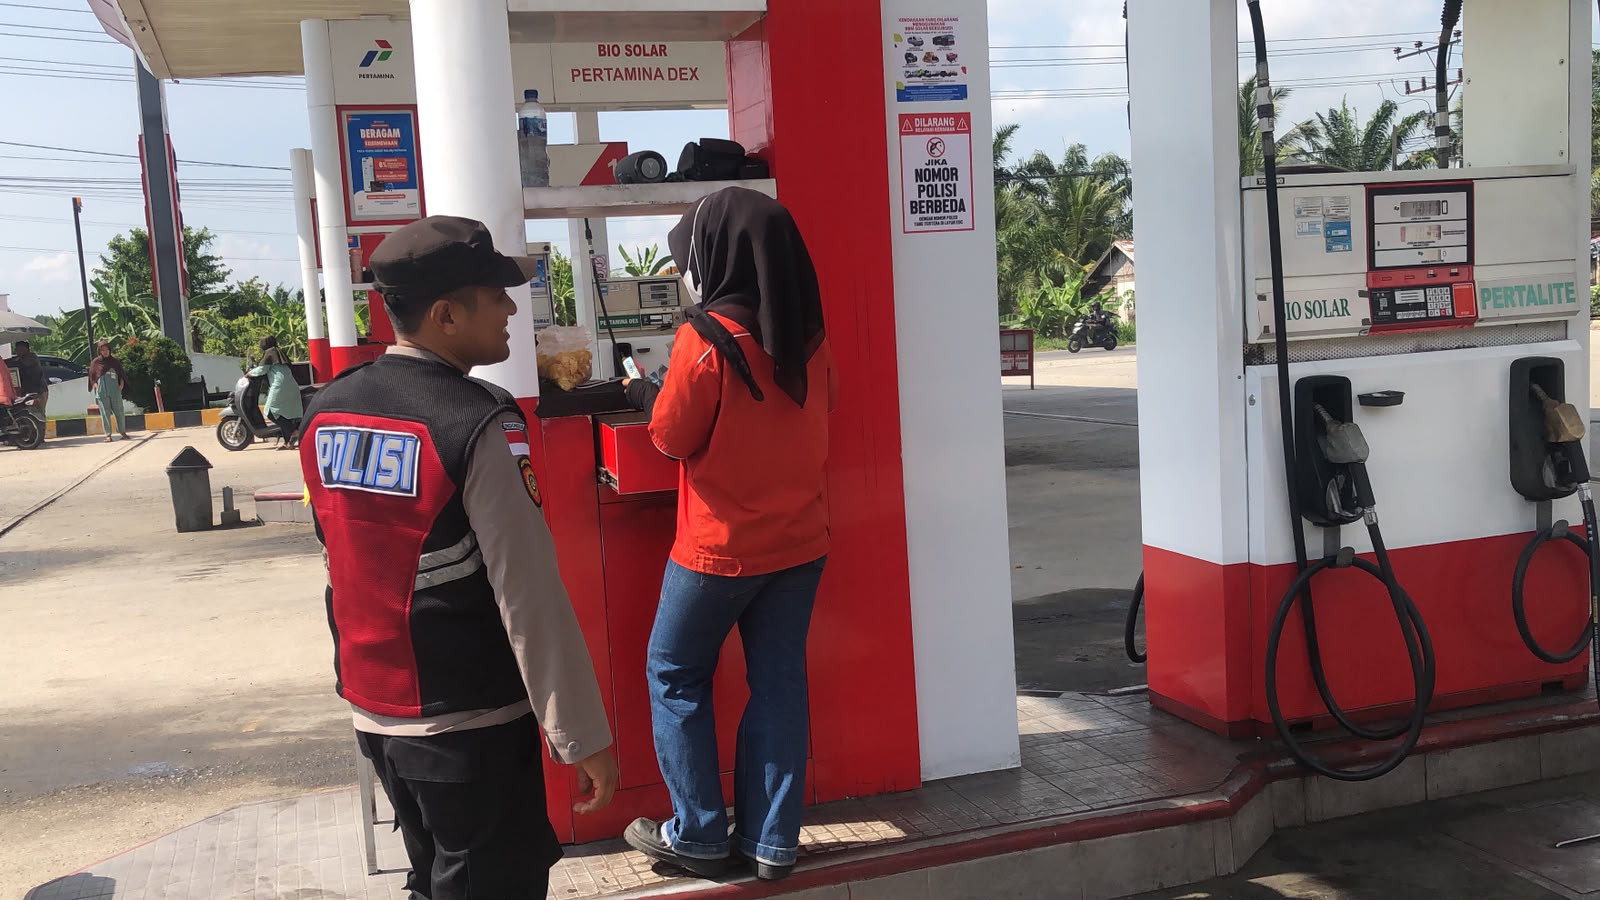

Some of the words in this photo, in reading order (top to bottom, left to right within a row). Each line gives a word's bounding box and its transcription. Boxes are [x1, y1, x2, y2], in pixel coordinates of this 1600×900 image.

[598, 44, 620, 57] BIO
[624, 44, 667, 57] SOLAR
[571, 67, 665, 82] PERTAMINA
[667, 67, 700, 81] DEX
[914, 117, 955, 127] DILARANG
[360, 128, 401, 139] BERAGAM
[914, 167, 959, 183] NOMOR
[917, 183, 957, 198] POLISI
[910, 198, 966, 215] BERBEDA
[1480, 281, 1576, 310] PERTALITE
[1284, 301, 1301, 320] IO
[1304, 298, 1351, 320] SOLAR
[318, 431, 416, 491] POLISI
